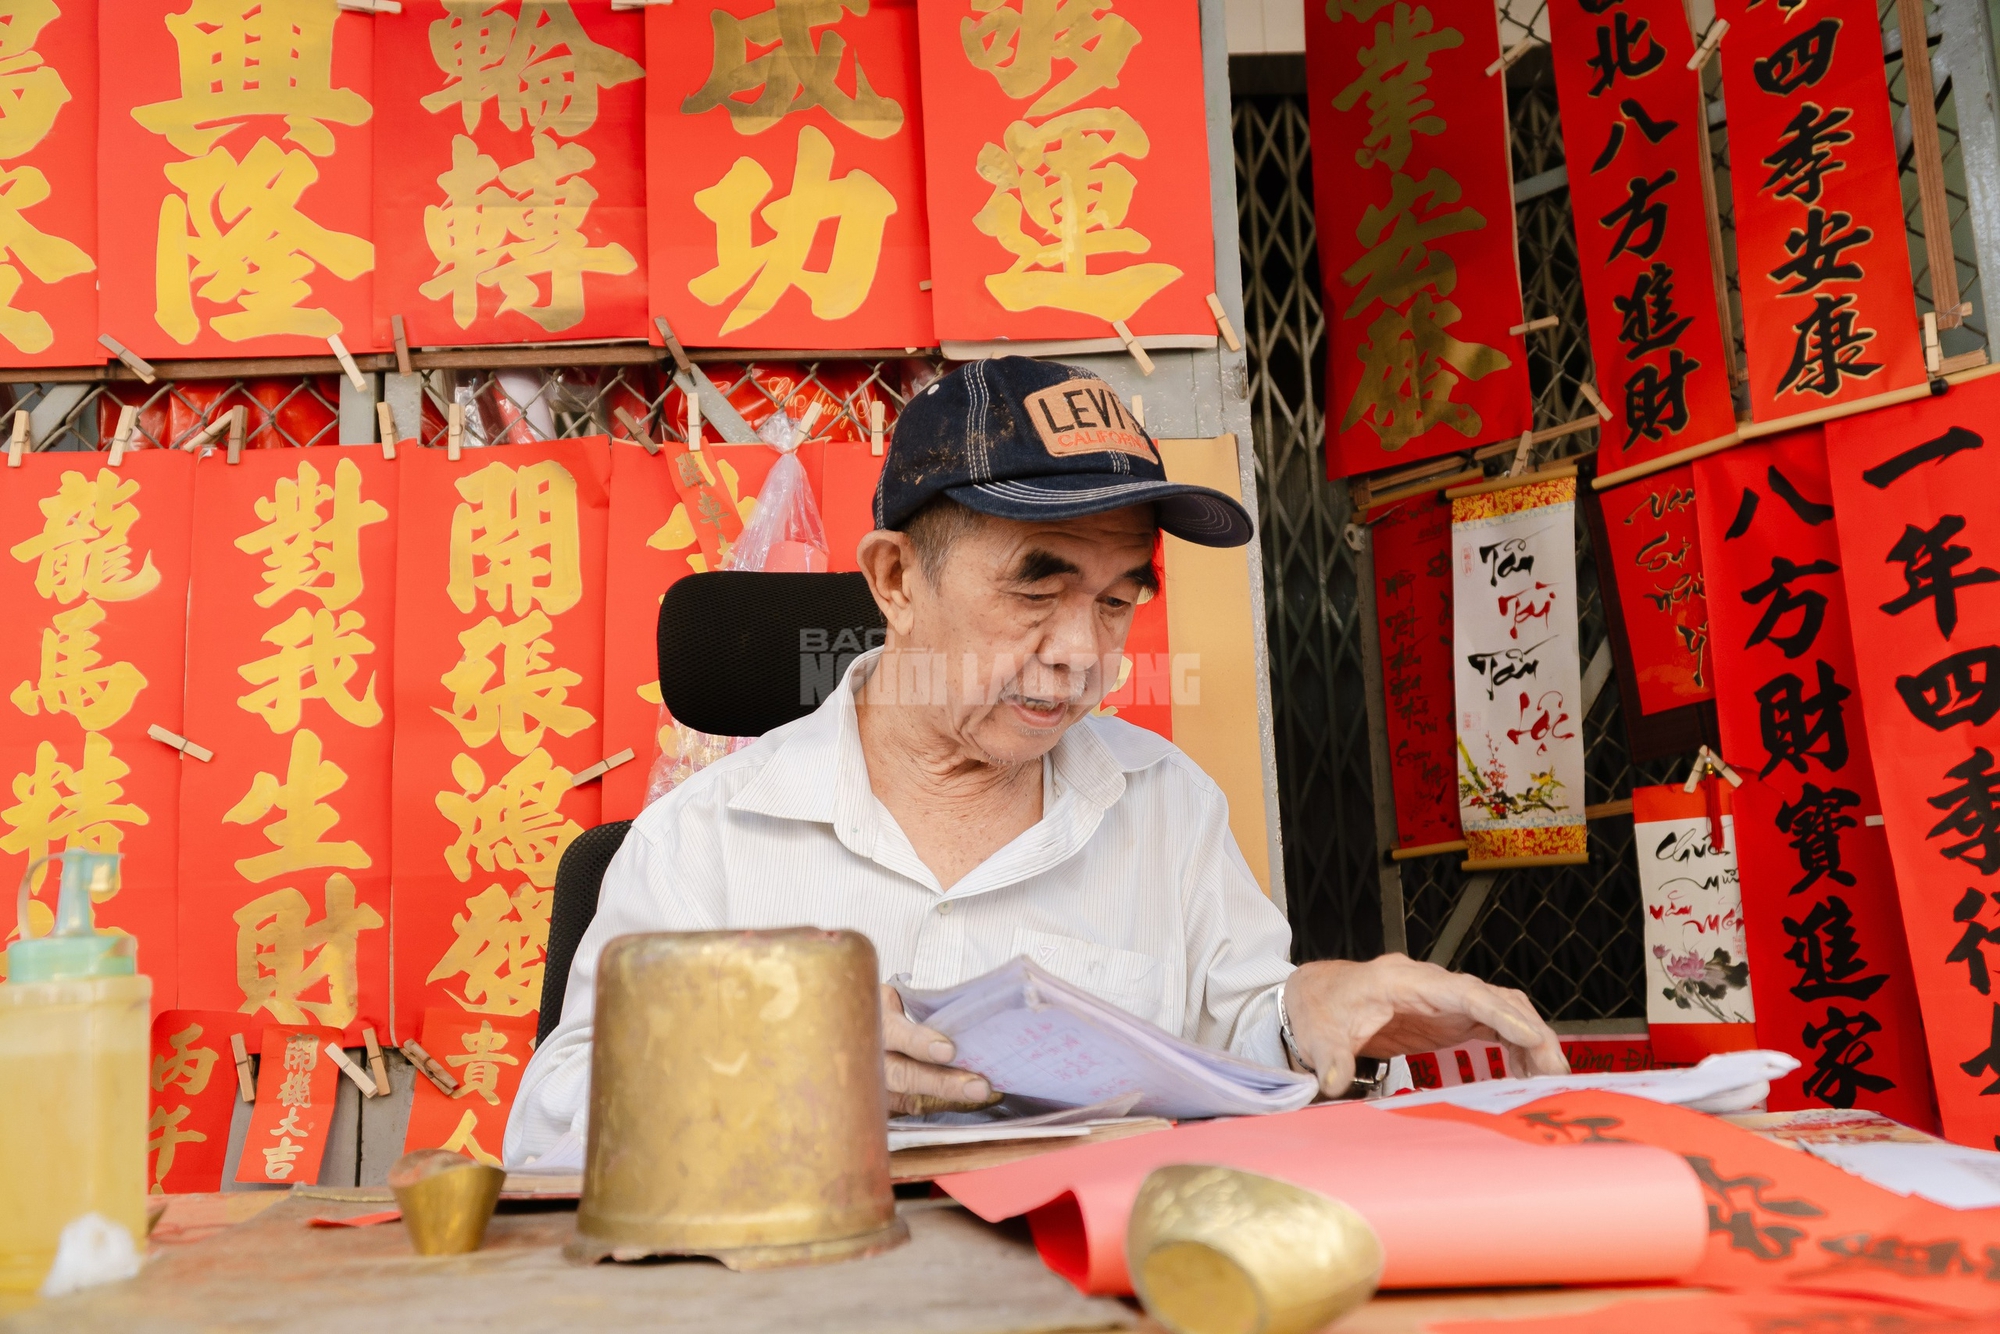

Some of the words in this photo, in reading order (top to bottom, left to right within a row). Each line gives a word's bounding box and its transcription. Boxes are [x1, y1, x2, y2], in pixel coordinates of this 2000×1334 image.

[681, 0, 904, 337] 成功
[1579, 0, 1701, 451] 北八方進財
[1746, 0, 1885, 402] 四季安康
[149, 1023, 219, 1194] 丙午
